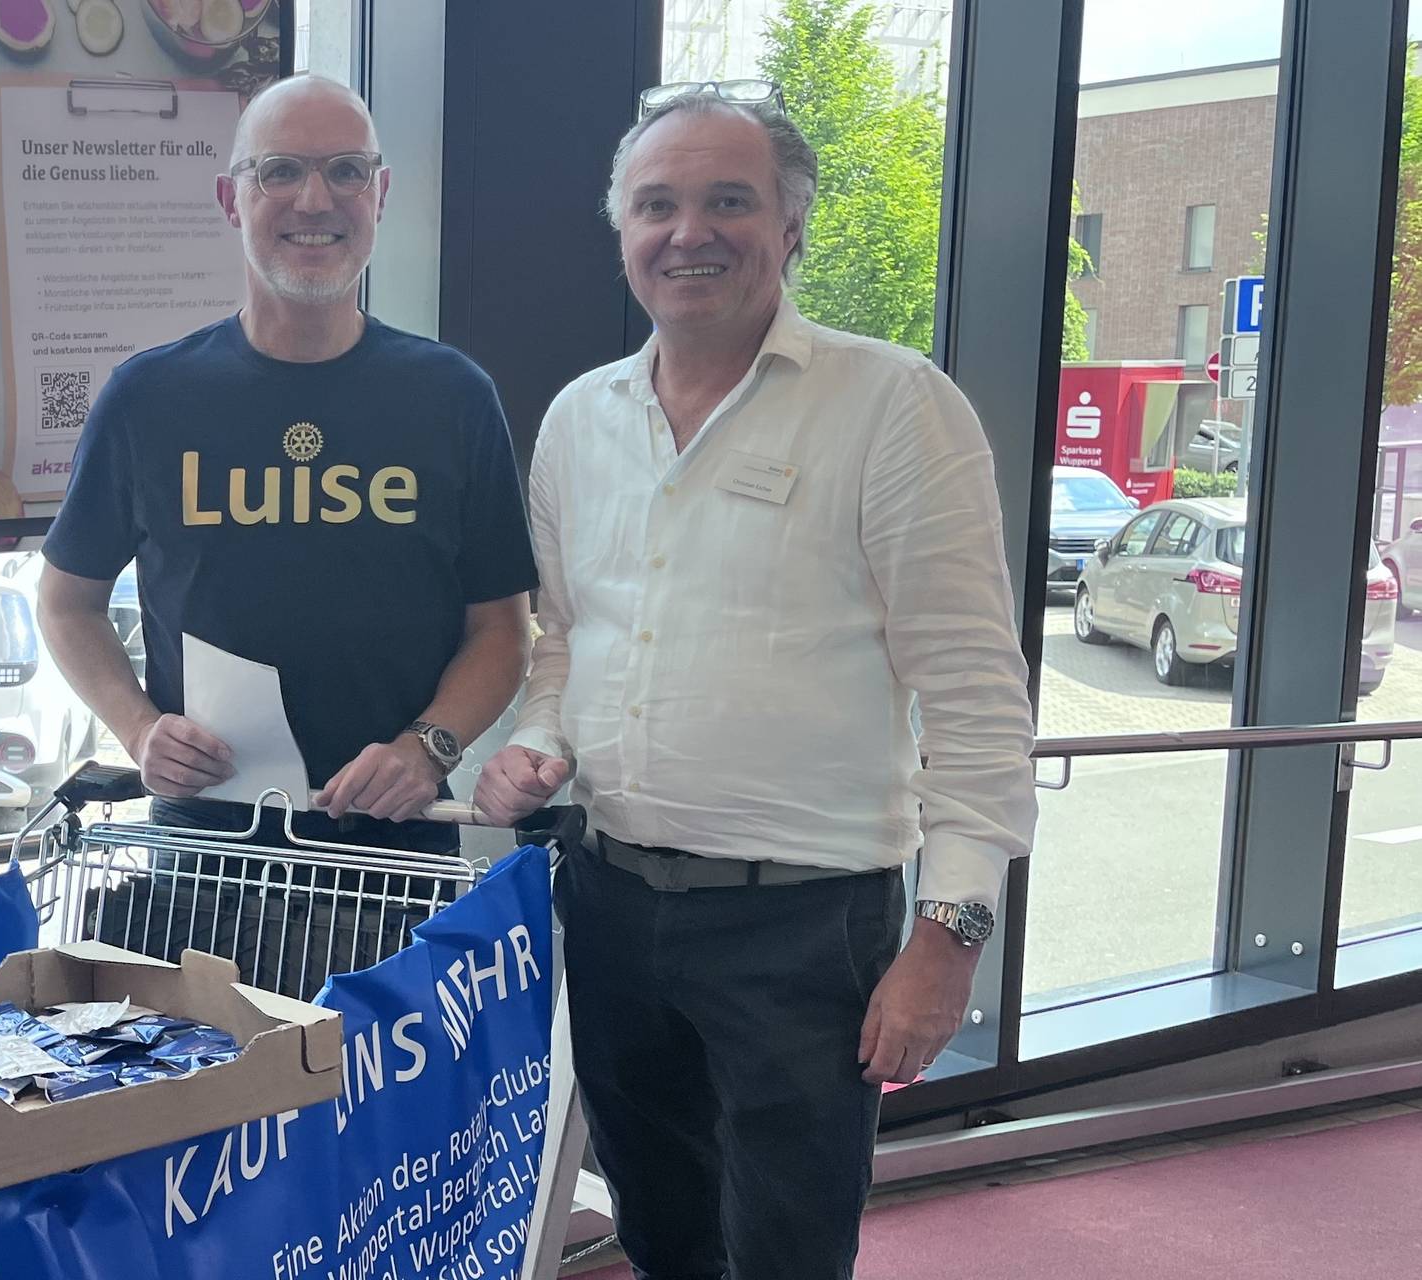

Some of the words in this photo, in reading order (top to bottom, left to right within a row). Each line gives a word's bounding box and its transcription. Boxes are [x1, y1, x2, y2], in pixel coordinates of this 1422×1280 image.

[22, 140, 68, 155] Unser
[73, 140, 156, 156] Newsletter
[160, 141, 182, 156] für
[186, 141, 217, 159] alle,
[22, 165, 46, 180] die
[50, 165, 106, 181] Genuss
[110, 165, 160, 181] lieben.
[32, 332, 71, 341] QR-Code
[73, 331, 108, 340] scannen
[33, 348, 48, 356] und
[50, 347, 92, 355] kostenlos
[1061, 445, 1102, 456] Sparkasse
[1059, 457, 1102, 467] Wuppertal
[182, 450, 418, 526] Luise
[335, 1012, 427, 1135] INS
[272, 1235, 324, 1280] Eine
[337, 1176, 385, 1254] Aktion
[392, 1152, 441, 1192] der
[409, 1152, 542, 1274] Wuppertal-L
